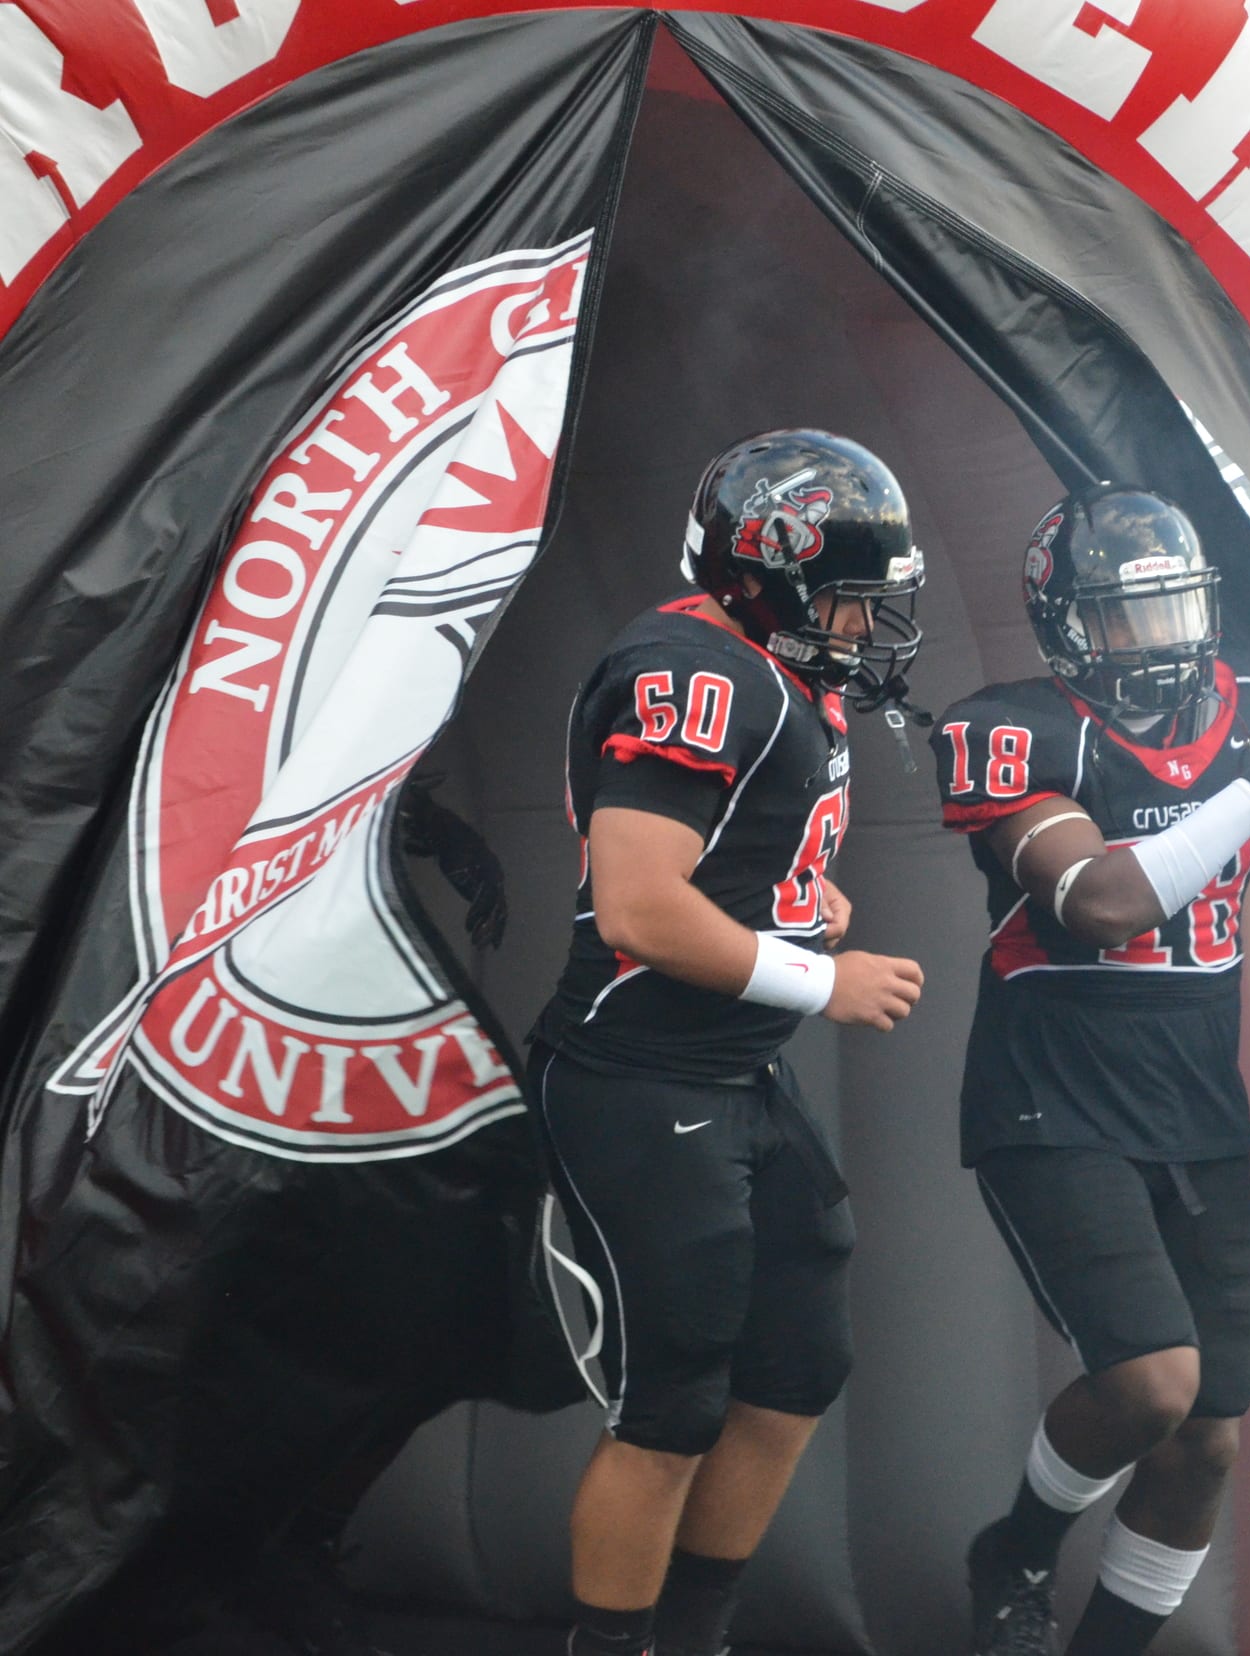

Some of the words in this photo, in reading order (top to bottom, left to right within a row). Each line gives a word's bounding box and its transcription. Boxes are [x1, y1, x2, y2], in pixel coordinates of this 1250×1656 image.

[188, 341, 451, 713] NORTH
[634, 669, 735, 753] 60
[941, 720, 1033, 798] 18
